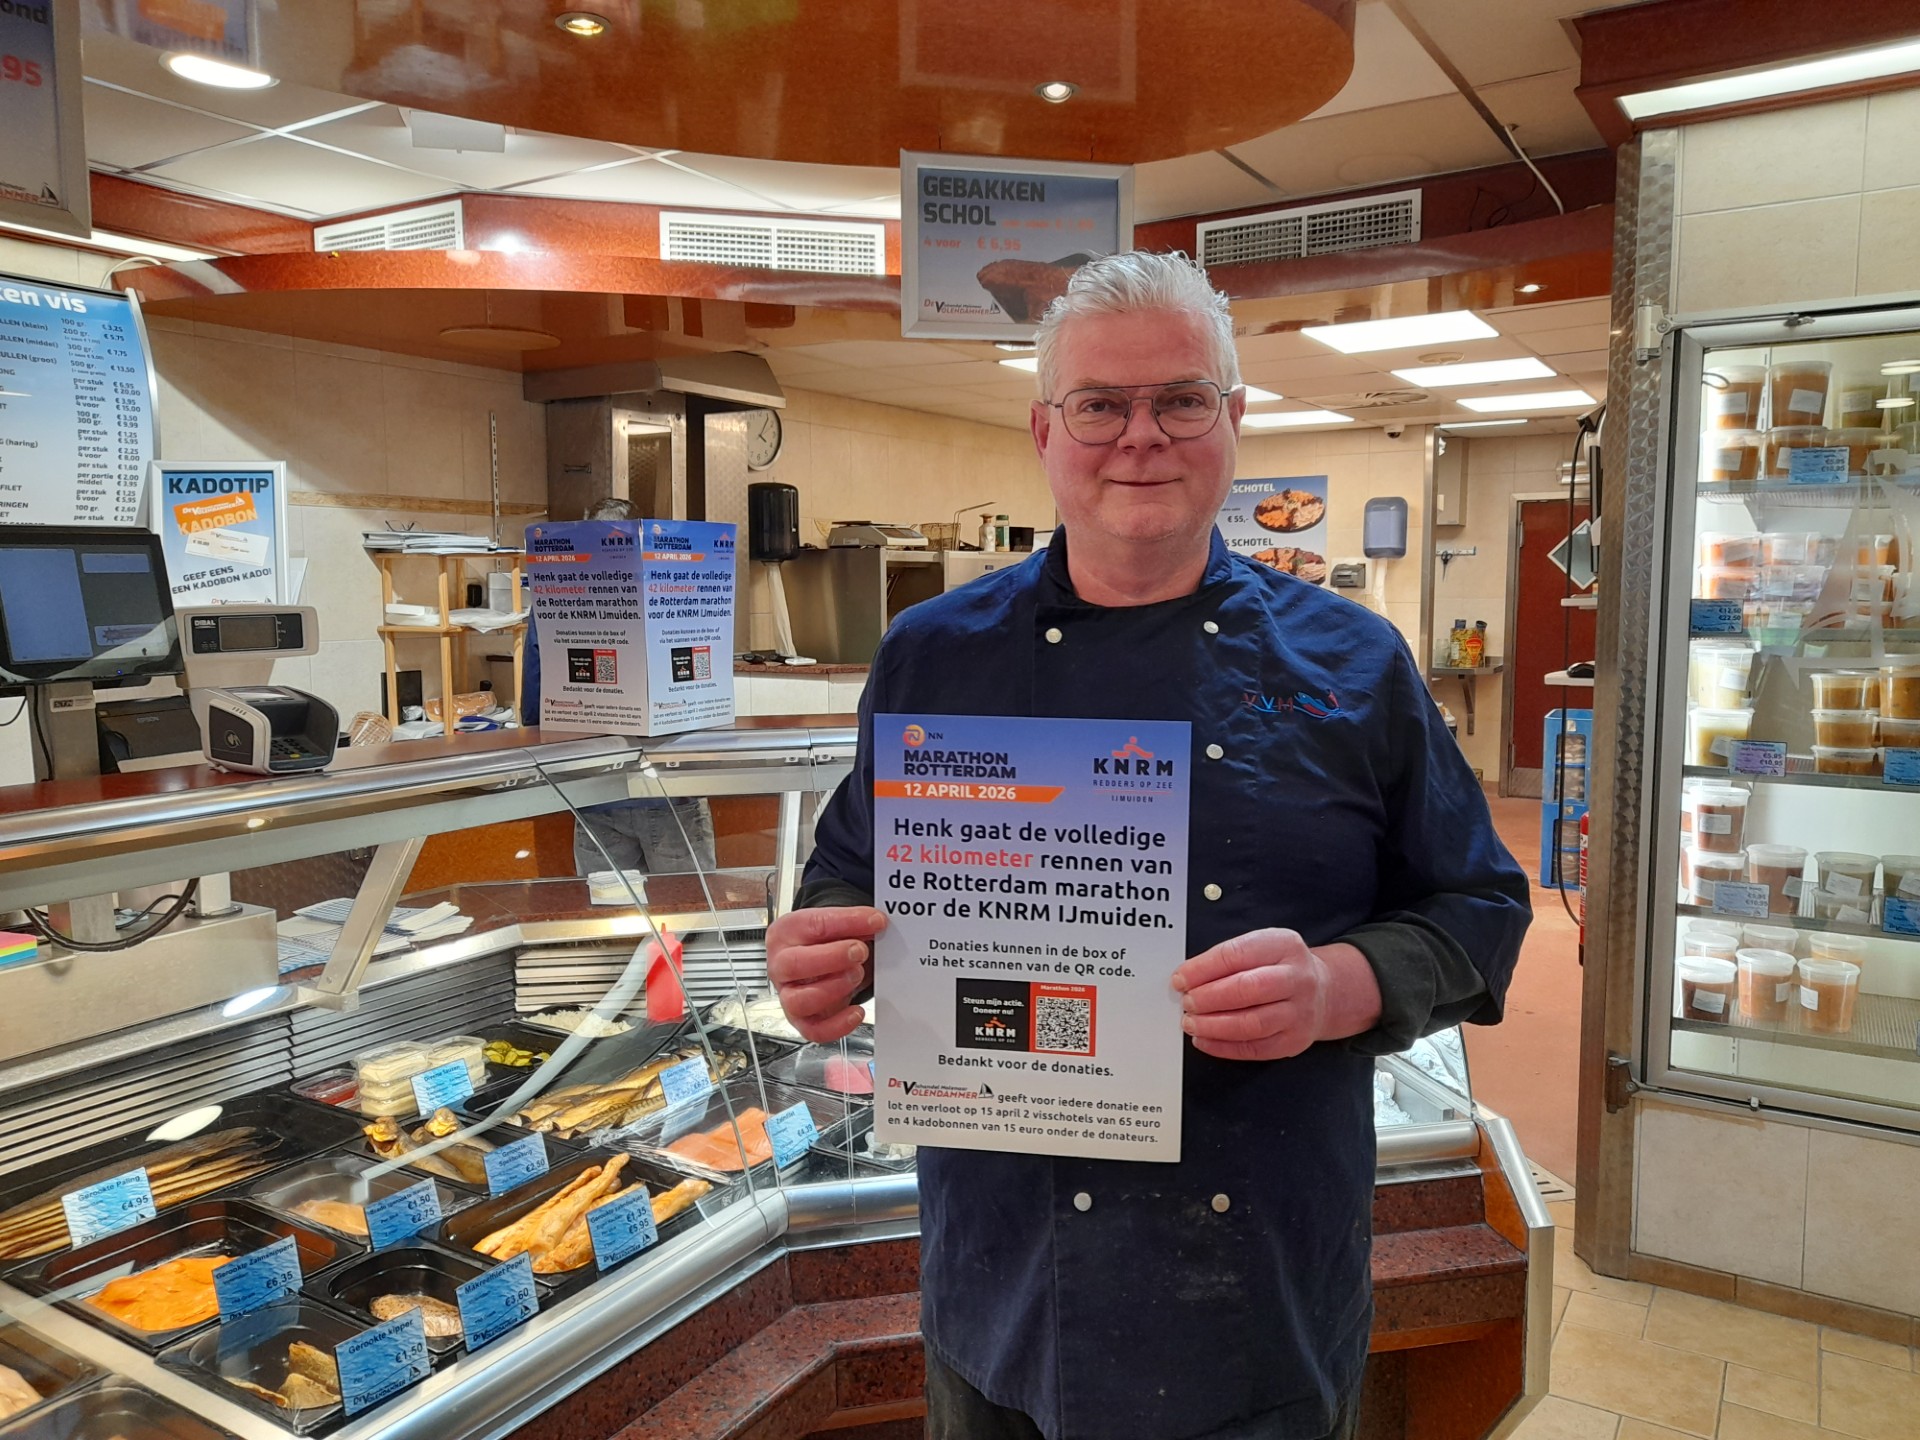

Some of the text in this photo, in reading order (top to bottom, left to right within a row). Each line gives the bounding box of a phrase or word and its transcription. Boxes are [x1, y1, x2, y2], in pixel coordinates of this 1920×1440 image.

[923, 176, 1045, 202] GEBAKKEN
[923, 202, 997, 226] SCHOL
[936, 239, 962, 248] voor
[44, 292, 87, 313] vis
[22, 321, 48, 331] (klein)
[61, 318, 74, 326] 100
[26, 337, 59, 349] (middel)
[28, 354, 57, 365] (groot)
[5, 439, 38, 448] (haring)
[168, 477, 269, 494] KADOTIP
[1232, 483, 1275, 494] SCHOTEL
[178, 508, 258, 535] KADOBON
[1231, 538, 1274, 547] SCHOTEL
[561, 554, 576, 562] 2026
[172, 567, 272, 595] EEN KADOBON KADO!
[183, 565, 234, 582] GEEF EENS
[533, 570, 633, 583] Henk gaat de volledige
[533, 585, 638, 594] 42 kilometer rennen van
[536, 597, 639, 607] de Rotterdam marathon
[537, 610, 641, 620] voor de KNRM IJmuiden.
[928, 732, 943, 741] NN
[904, 749, 1008, 765] MARATHON
[904, 763, 1016, 779] ROTTERDAM
[1093, 758, 1174, 777] KNRM
[904, 783, 1016, 800] 12 APRIL 2026
[1093, 779, 1174, 789] REDDERS OP ZEE
[894, 818, 1166, 851] Henk gaat de volledige
[886, 844, 1173, 875] 42 kilometer rennen van
[888, 869, 1170, 902] de Rotterdam marathon
[884, 898, 1174, 929] voor de KNRM IJmuiden.
[929, 939, 1127, 961] Donaties kunnen in de box of
[919, 955, 1136, 978] via het scannen van de QR code.
[1041, 984, 1070, 992] Marathon
[963, 996, 1025, 1007] Steun mijn actie.
[973, 1006, 1015, 1016] Doneer nu!
[975, 1026, 1016, 1038] KNRM
[938, 1054, 1114, 1077] Bedankt voor de donaties.
[902, 1080, 979, 1099] VOLENDAMMER
[997, 1093, 1163, 1114] geeft voor iedere donatie een
[888, 1100, 1161, 1129] lot en verloot op 15 april 2 visschotels van 65 euro
[888, 1116, 1159, 1143] en 4 kadobonnen van 15 euro onder de donateurs.
[78, 1175, 141, 1201] Gerookte Paling
[215, 1242, 294, 1280] Gerookte Zalmsnippers
[464, 1257, 526, 1294] Makreelfilet Peper
[348, 1319, 414, 1355] Gerookte kipper
